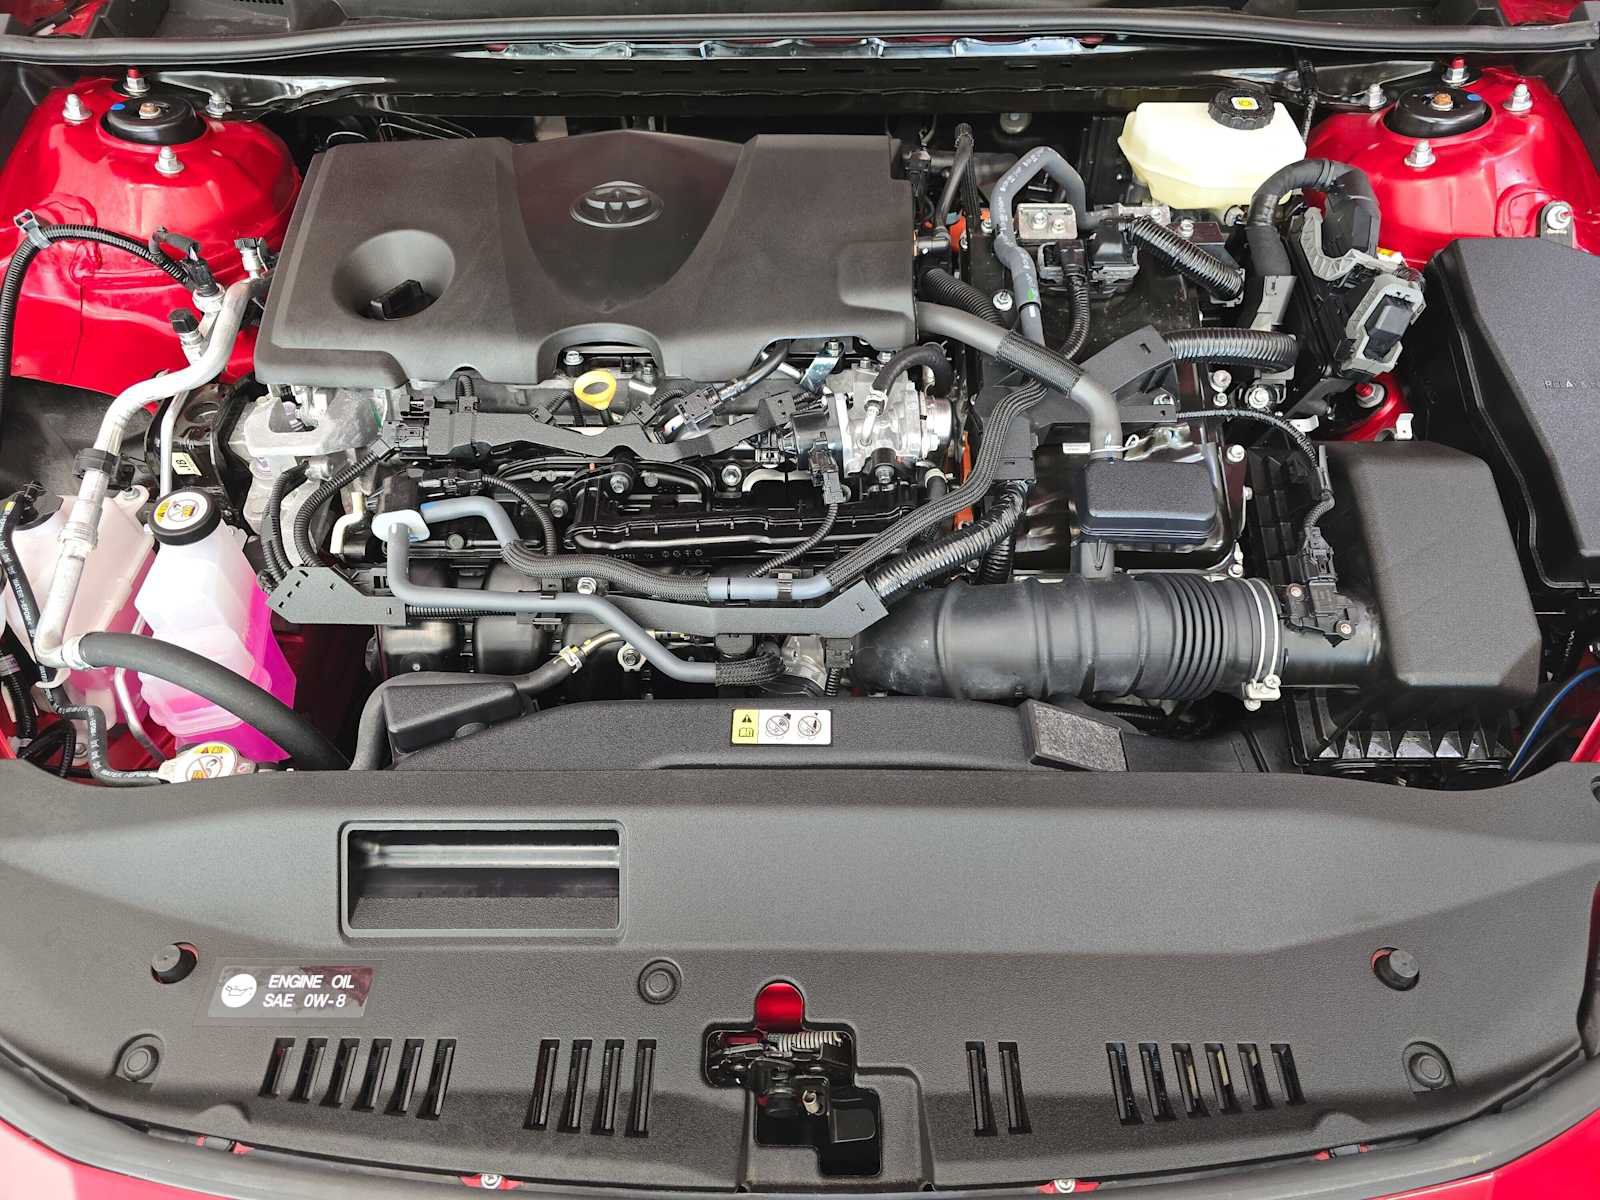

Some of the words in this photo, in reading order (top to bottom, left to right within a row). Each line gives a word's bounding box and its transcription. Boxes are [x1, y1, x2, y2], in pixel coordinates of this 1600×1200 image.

[268, 974, 324, 989] ENGINE
[331, 974, 355, 989] OIL
[262, 993, 296, 1008] SAE
[303, 993, 347, 1008] 0W-8
